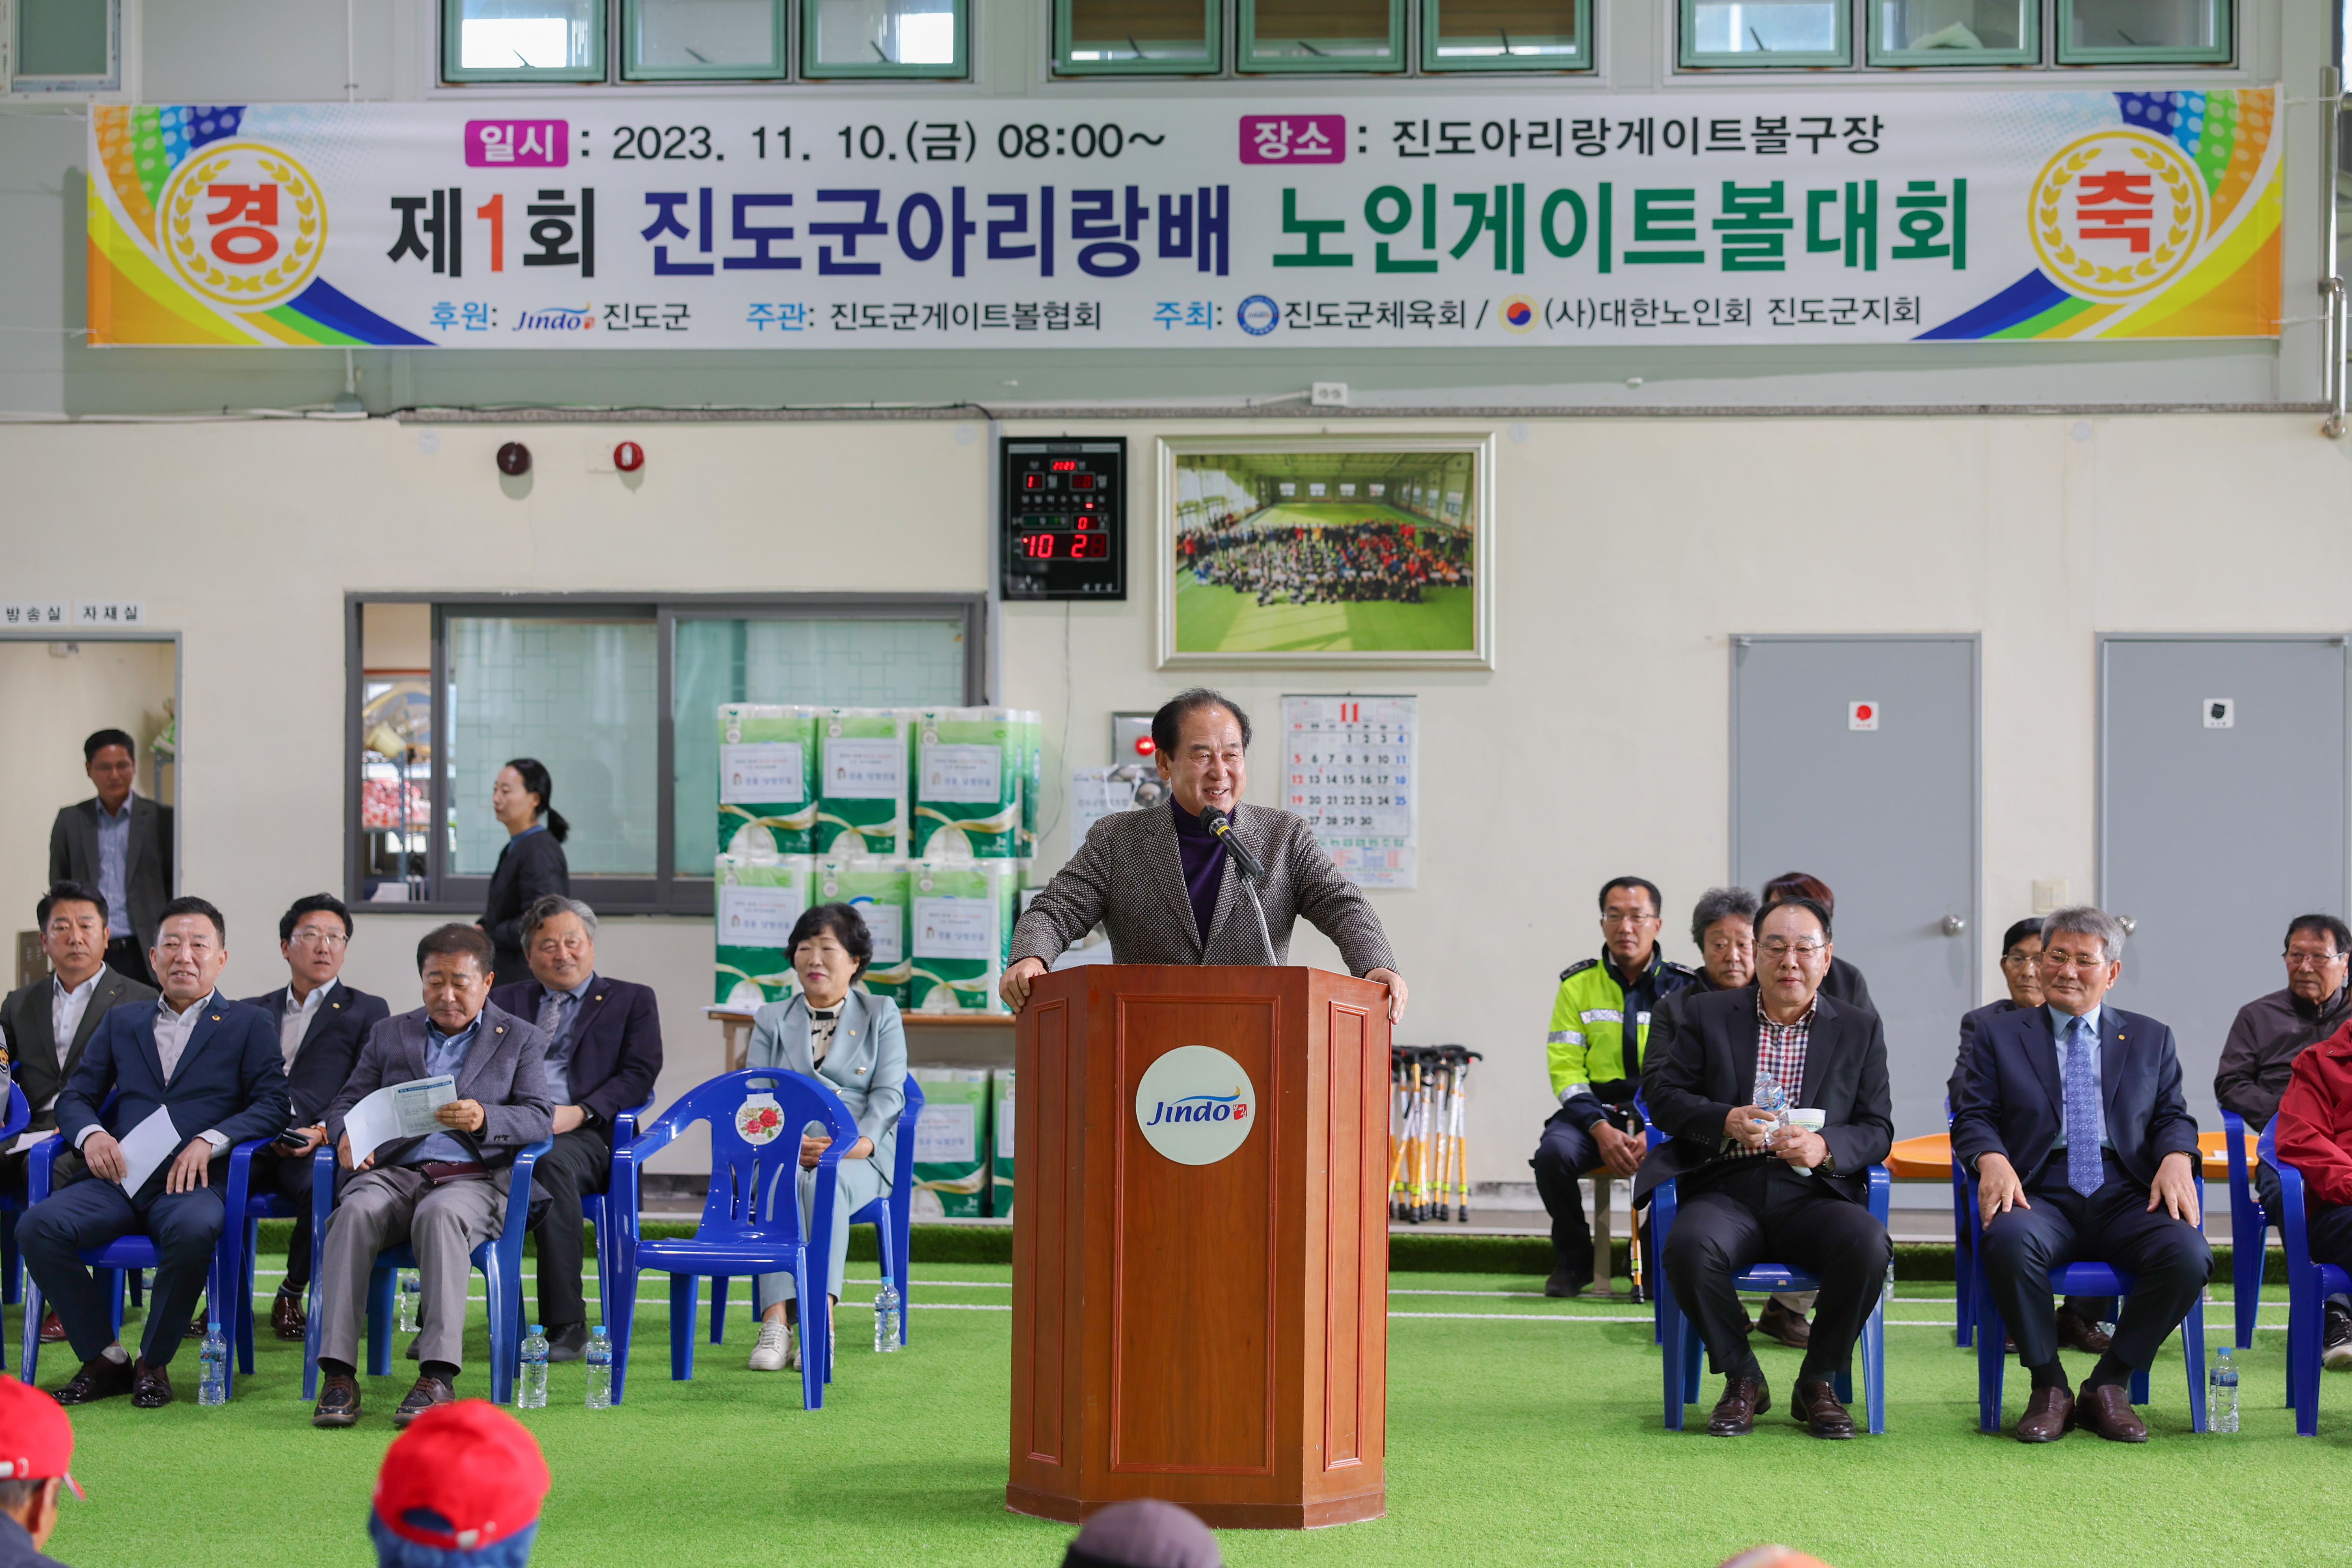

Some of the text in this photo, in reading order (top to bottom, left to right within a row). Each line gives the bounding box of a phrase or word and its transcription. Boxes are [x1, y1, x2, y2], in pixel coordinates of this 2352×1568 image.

[479, 125, 554, 162] 일시
[613, 125, 724, 162] 2023.
[752, 126, 810, 161] 11.
[1253, 121, 1333, 159] 장소
[1392, 114, 1884, 158] 진도아리랑게이트볼구장
[206, 183, 279, 266] 경
[2076, 171, 2155, 253] 축
[386, 178, 1968, 278] 제1회 진도군아리랑배 노인게이트볼대회
[512, 308, 581, 331] Jindo
[603, 302, 691, 331] 진도군
[831, 301, 1100, 331] 진도군게이트볼협회
[1284, 300, 1465, 329] 진도군체육회
[1544, 298, 1751, 329] (사)대한노인회
[1768, 296, 1920, 326] 진도군지회
[1028, 534, 1054, 558] 10
[6, 606, 61, 622] 방송실
[83, 606, 137, 621] 자재실
[1340, 702, 1359, 723] 11
[1378, 755, 1389, 763] 10
[1396, 755, 1406, 763] 11
[1146, 1101, 1231, 1126] Jindo
